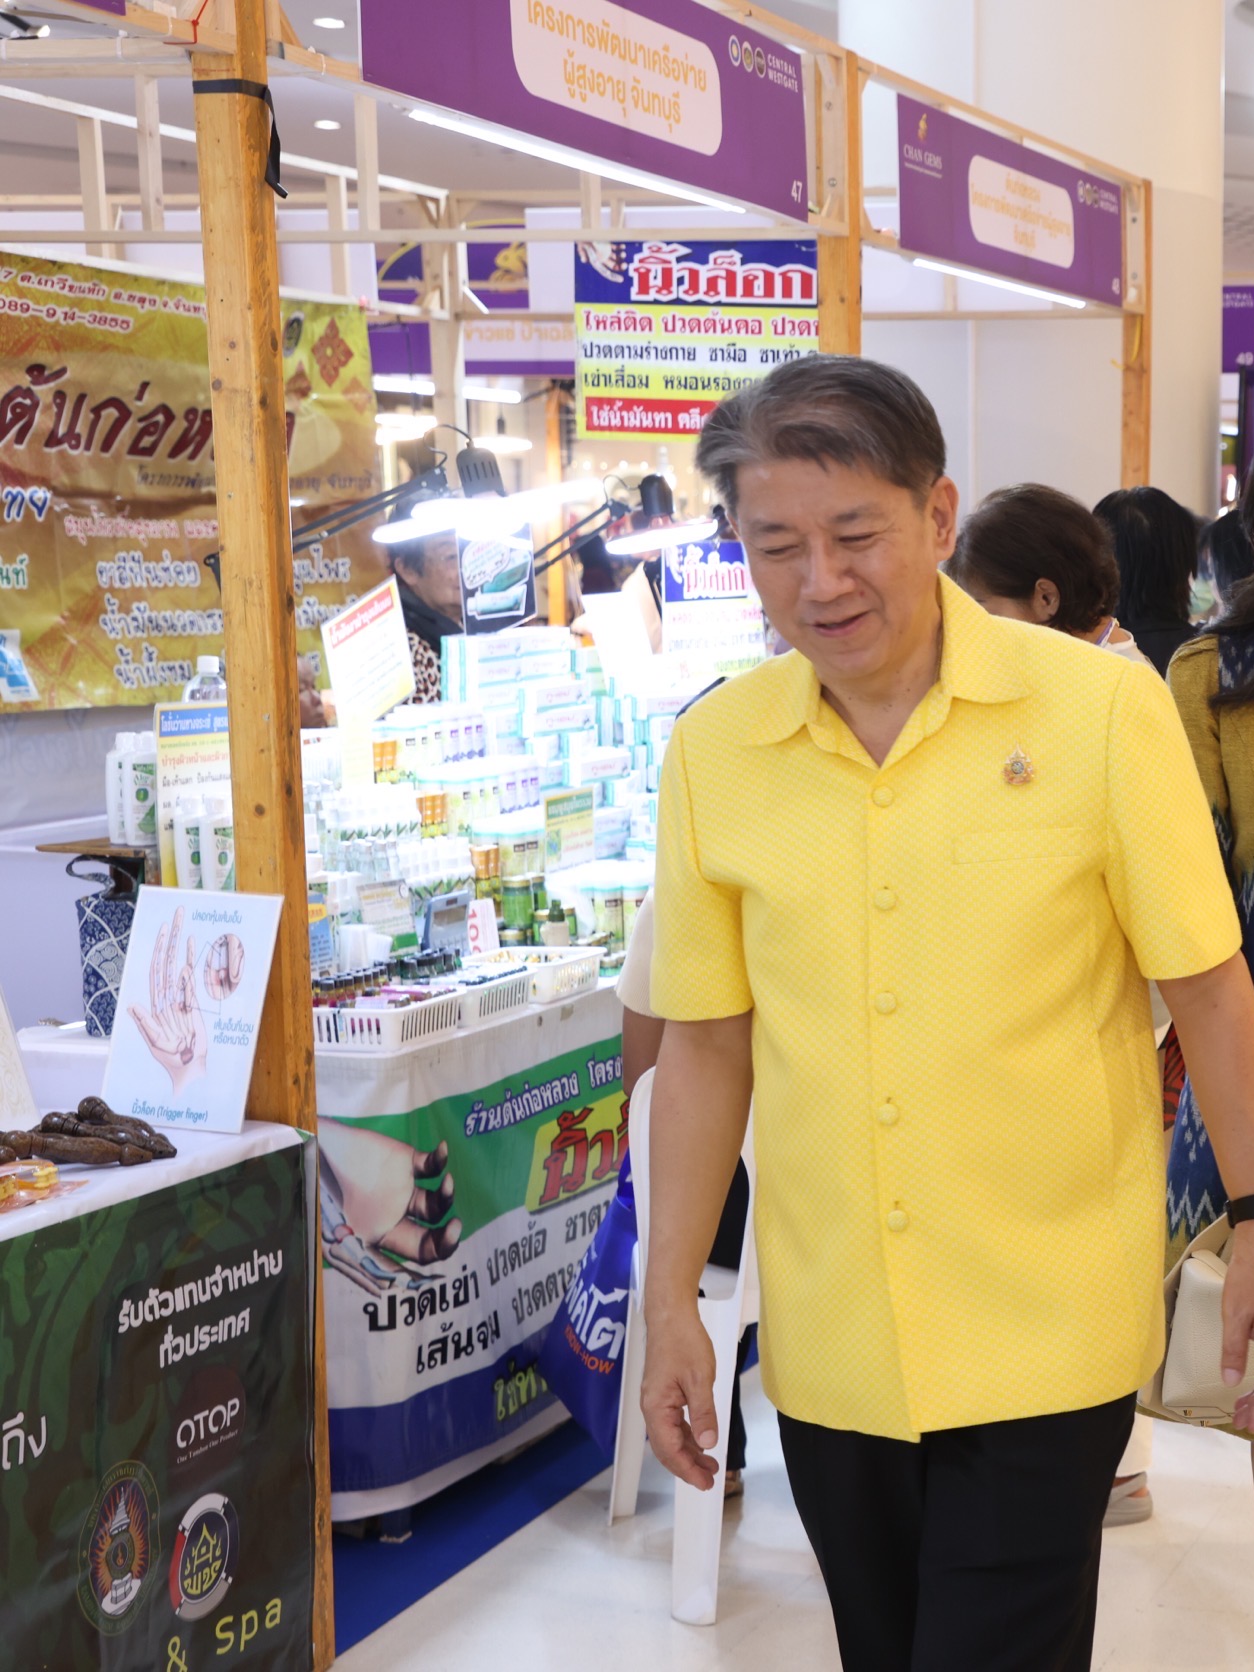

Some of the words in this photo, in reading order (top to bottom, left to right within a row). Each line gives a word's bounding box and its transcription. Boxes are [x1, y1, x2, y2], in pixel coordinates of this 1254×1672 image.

[526, 0, 708, 93] โครงการพัฒนาเครือข่าย
[766, 53, 797, 79] CENTRAL
[562, 49, 627, 119] ผู้สูงอายุ
[630, 76, 682, 134] จันทบุรี
[767, 68, 799, 94] WESTGATE
[903, 143, 923, 163] CHAN
[790, 179, 804, 203] 47
[628, 242, 817, 304] นิ้วล็อก
[583, 308, 654, 334] ไหล่ติด
[662, 310, 763, 337] ปวดต้นคอ
[771, 316, 819, 337] ปวด
[582, 341, 696, 362] ปวดตามร่างกาย
[709, 342, 748, 363] ชามือ
[760, 344, 801, 364] ชาเท้า
[1235, 352, 1254, 366] 49
[584, 365, 650, 390] เข่าเสื่อม
[663, 373, 762, 393] หมอนรองก
[0, 363, 214, 461] ต้นก่อห
[591, 401, 674, 429] ใช้น้ำมันทา
[156, 1103, 184, 1123] (Trigger
[185, 1106, 208, 1124] finger)
[464, 1071, 580, 1138] ร้านต้นก่อหลวง
[586, 1052, 623, 1089] โครง
[118, 1249, 284, 1334] รับตัวแทนจำหน่าย
[362, 1264, 481, 1332] ปวดเข่า
[486, 1220, 547, 1287] ปวดข้อ
[159, 1307, 251, 1369] ทั่วประเทศ
[2, 1411, 47, 1471] ถึง
[176, 1397, 240, 1449] OTOP
[215, 1597, 282, 1655] Spa
